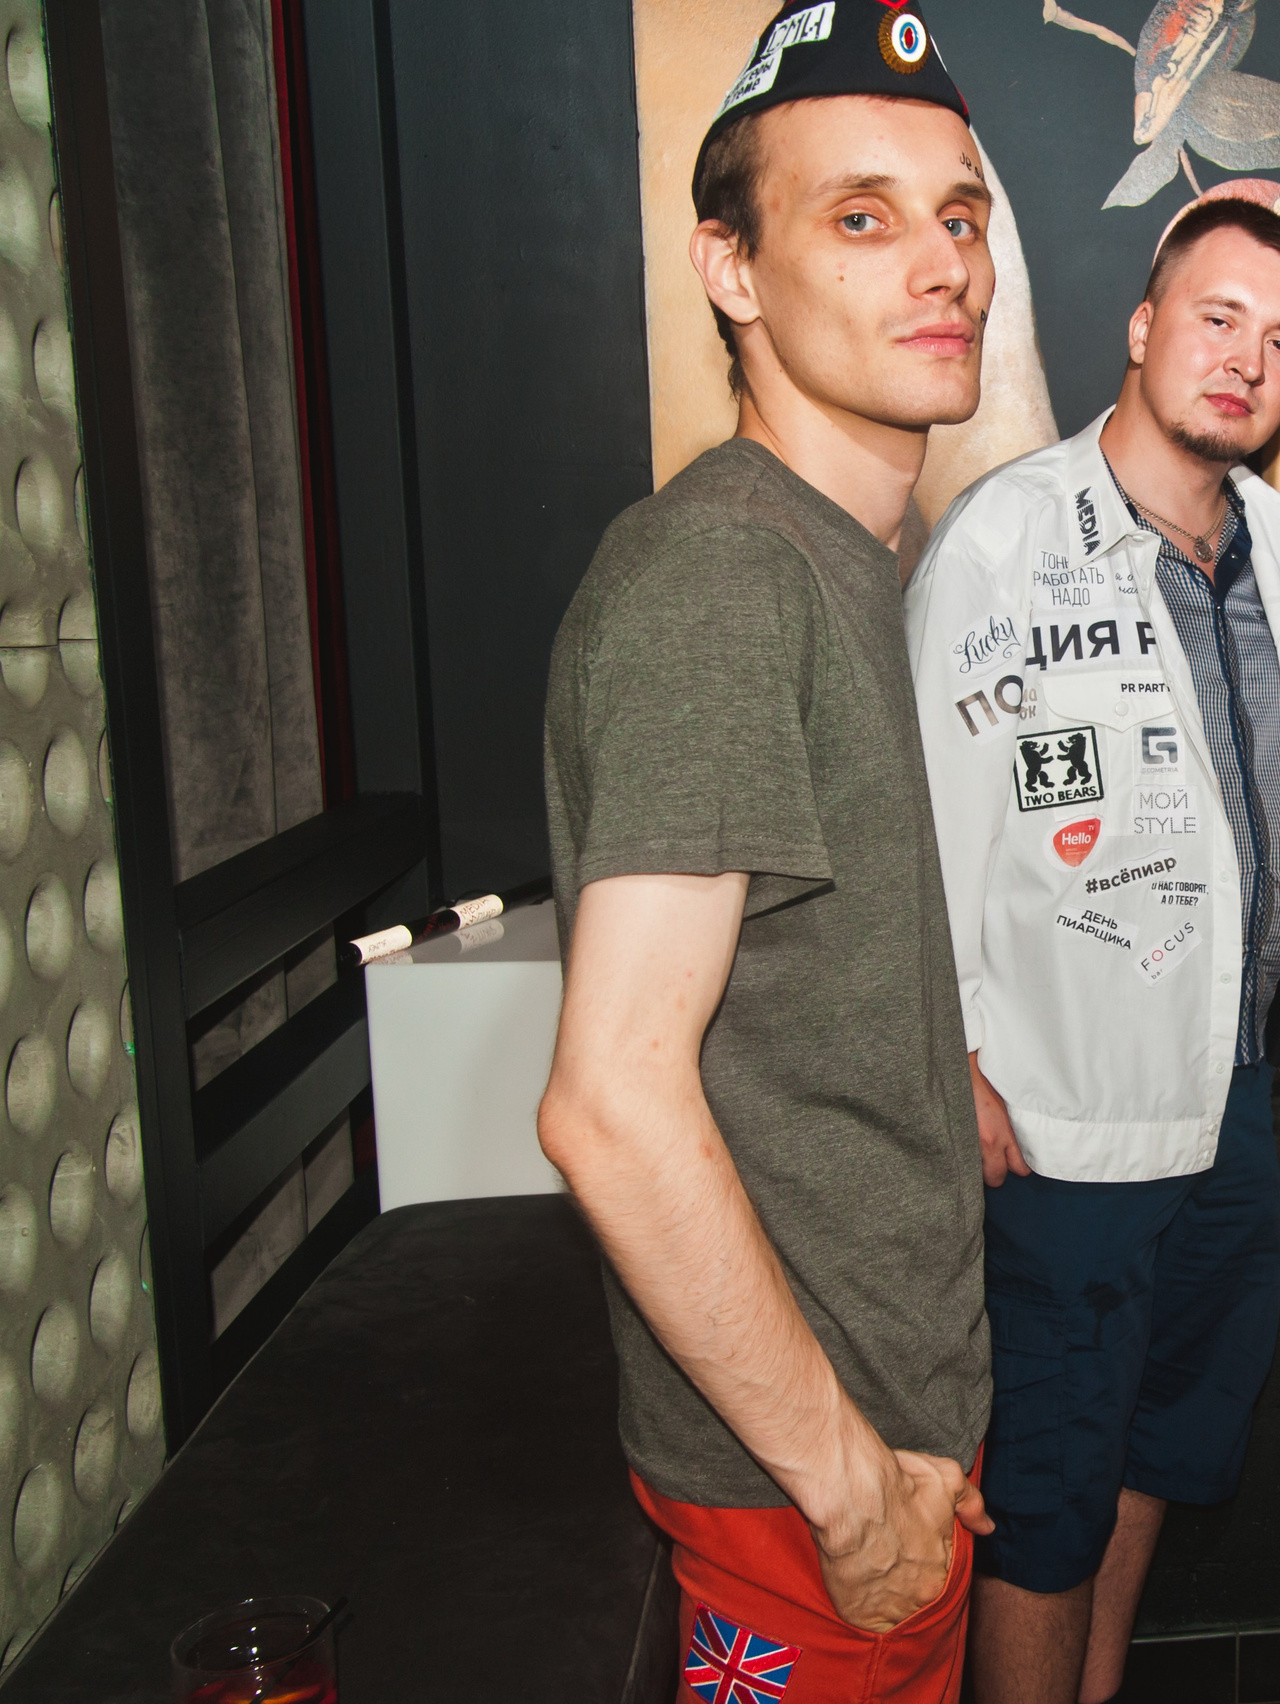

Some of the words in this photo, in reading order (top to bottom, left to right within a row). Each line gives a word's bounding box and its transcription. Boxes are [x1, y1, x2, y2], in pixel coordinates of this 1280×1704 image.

[1074, 486, 1101, 556] MEDIA
[1033, 567, 1105, 587] РАБОТАТЬ
[1051, 587, 1091, 608] НАДО
[953, 615, 1022, 674] Lucky
[1121, 683, 1136, 693] PR
[1024, 792, 1054, 806] TWO
[1058, 786, 1097, 801] BEARS
[1139, 789, 1188, 809] МОЙ
[1134, 817, 1196, 834] STYLE
[1061, 832, 1091, 845] Hello
[1085, 856, 1177, 894] #всёпиар
[1158, 881, 1173, 891] НАС
[1161, 895, 1166, 905] А
[1176, 895, 1198, 906] ТЕБЕ?
[1081, 909, 1119, 930] ДЕНЬ
[1056, 915, 1132, 949] ПИАРЩИКА
[1140, 921, 1195, 971] FOCUS
[1151, 968, 1164, 980] bar
